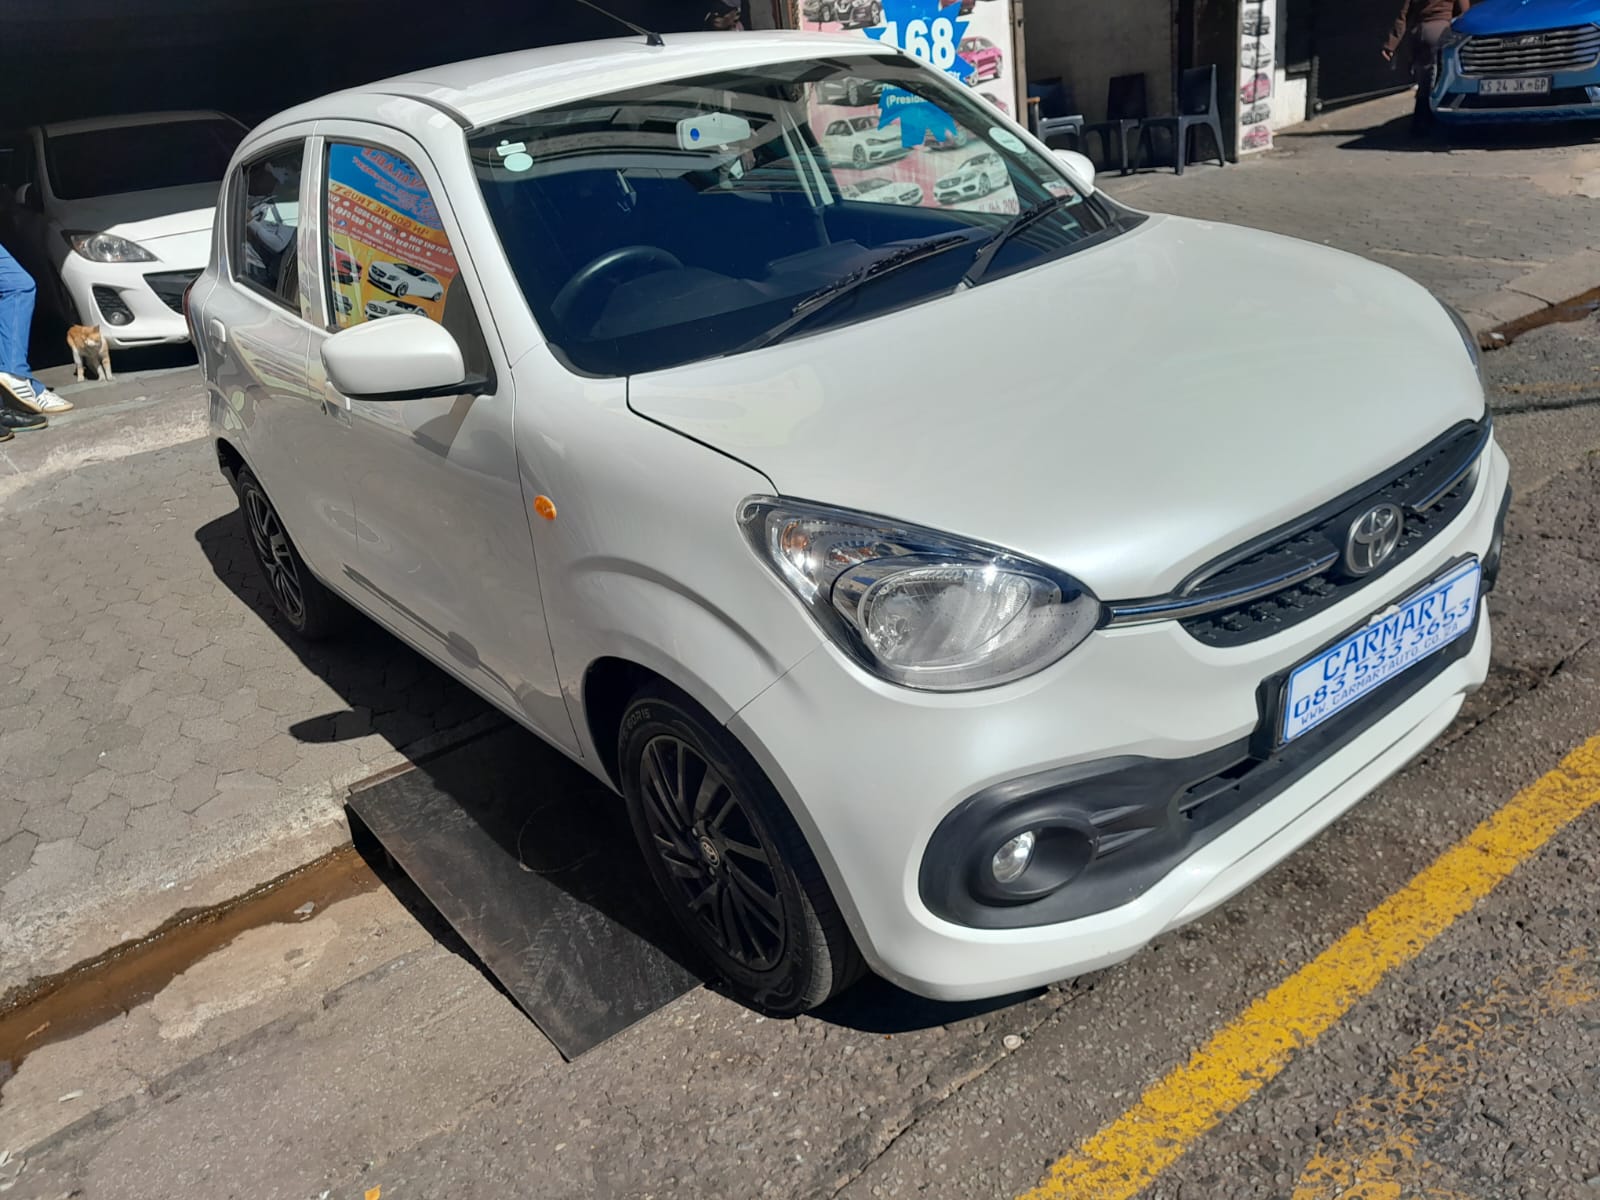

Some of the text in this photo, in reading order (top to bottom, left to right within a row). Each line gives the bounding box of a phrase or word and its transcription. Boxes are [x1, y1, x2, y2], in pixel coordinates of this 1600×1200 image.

[1293, 598, 1471, 718] 083 533 3653
[1323, 585, 1454, 681] CARMART
